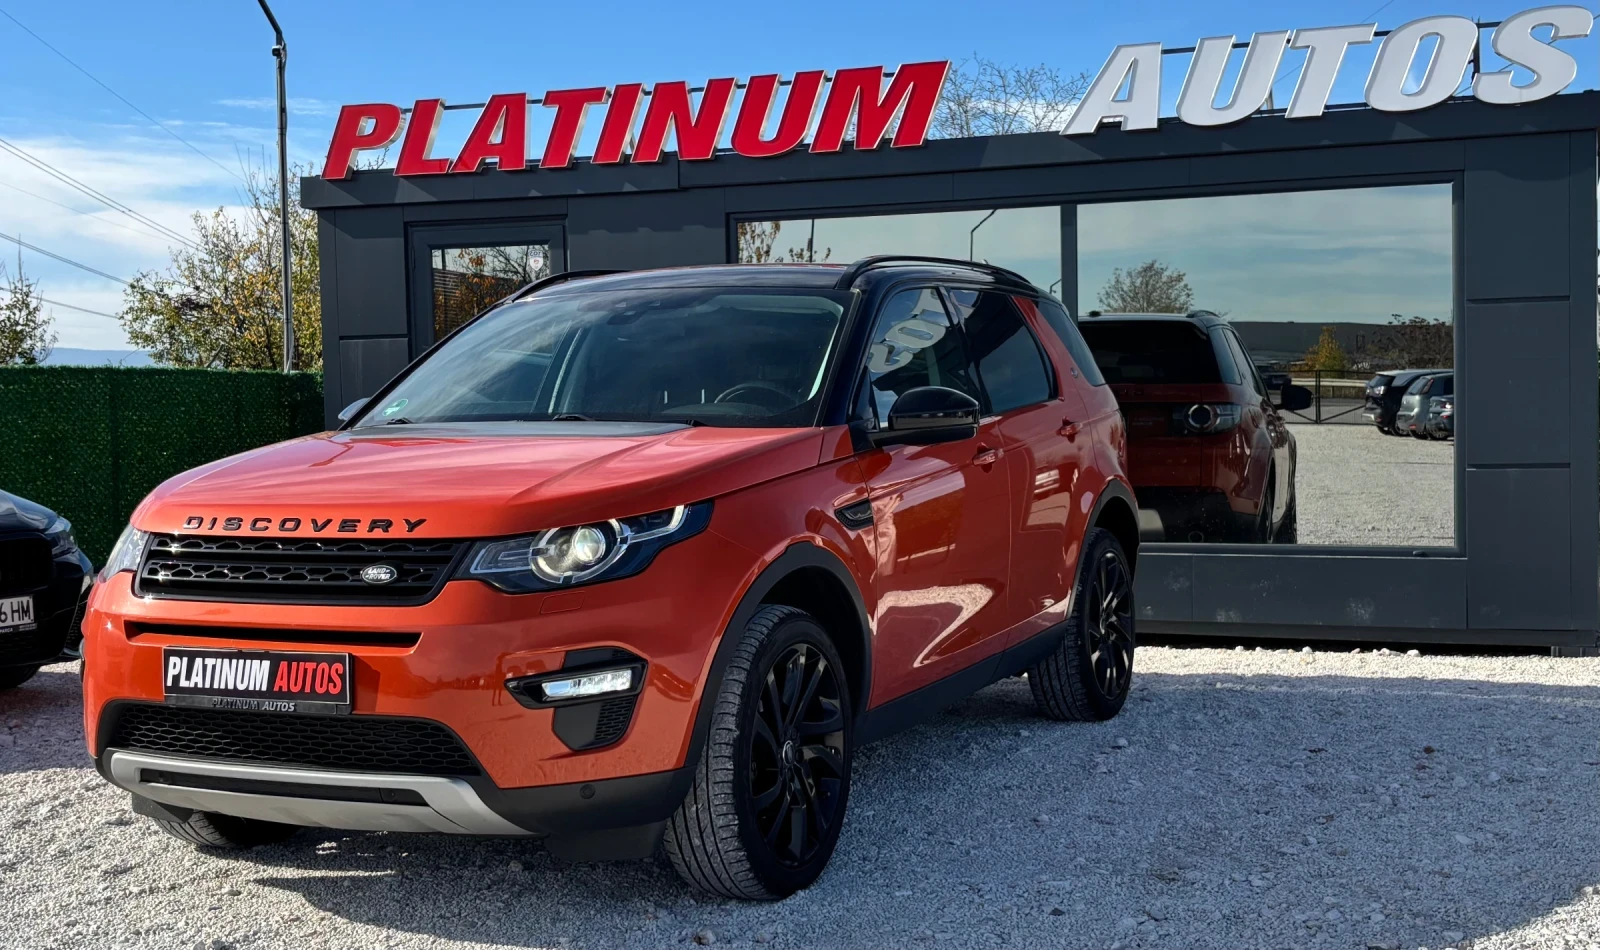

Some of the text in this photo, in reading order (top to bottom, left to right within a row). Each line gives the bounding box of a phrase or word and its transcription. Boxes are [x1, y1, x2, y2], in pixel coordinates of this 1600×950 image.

[320, 4, 1594, 181] PLATINUM AUTOS
[183, 516, 427, 533] DISCOVERY
[10, 600, 31, 622] HM
[166, 656, 344, 695] PLATINUM AUTOS
[212, 698, 296, 712] PLATINUM AUTOS
